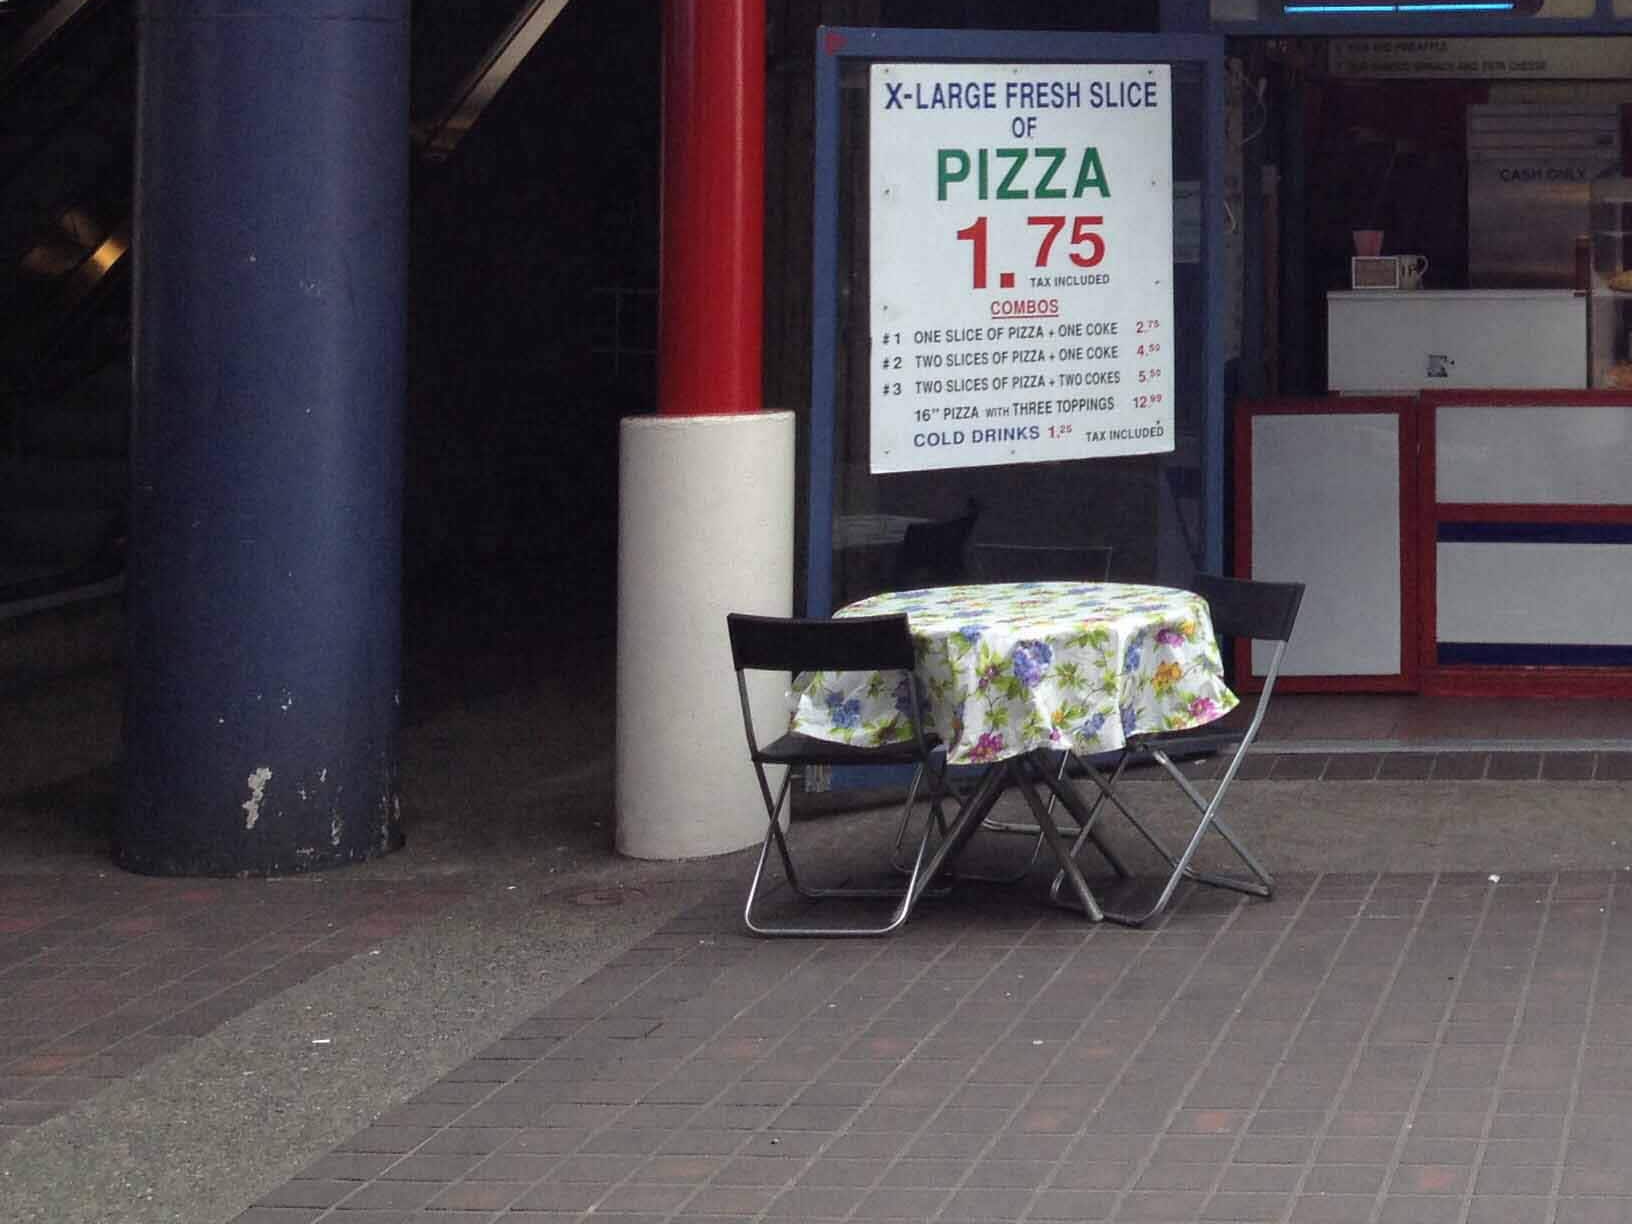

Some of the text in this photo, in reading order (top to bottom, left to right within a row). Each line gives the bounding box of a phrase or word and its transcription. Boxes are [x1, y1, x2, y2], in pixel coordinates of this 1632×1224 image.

[885, 81, 1158, 110] X-LARGE FRESH SLICE
[1012, 117, 1037, 137] OF
[937, 148, 1111, 200] PIZZA
[956, 216, 1106, 289] 1.75
[1030, 274, 1109, 287] TAX INCLUDED
[991, 300, 1058, 315] COMBOS
[914, 331, 943, 344] ONE
[946, 330, 982, 342] SLICE
[987, 329, 1004, 341] OF
[1009, 327, 1044, 339] PIZZA
[1058, 325, 1083, 337] ONE
[1086, 323, 1118, 336] COKE
[916, 355, 943, 368] TWO
[947, 353, 989, 367] SLICES
[992, 352, 1009, 364] OF
[1012, 350, 1045, 363] PIZZA
[1059, 348, 1084, 361] ONE
[1086, 346, 1118, 360] COKE
[916, 381, 943, 394] TWO
[947, 379, 989, 392] SLICES
[992, 377, 1009, 390] OF
[1012, 376, 1045, 389] PIZZA
[1059, 374, 1083, 386] TWO
[1085, 372, 1120, 385] COKES
[943, 406, 979, 419] PIZZA
[986, 407, 1010, 417] WITH
[1012, 402, 1052, 415] THREE
[1056, 397, 1115, 413] TOPPINGS
[914, 431, 965, 447] COLD
[972, 426, 1040, 444] DRINKS
[1086, 431, 1106, 442] TAX
[1109, 426, 1164, 440] INCLUDED
